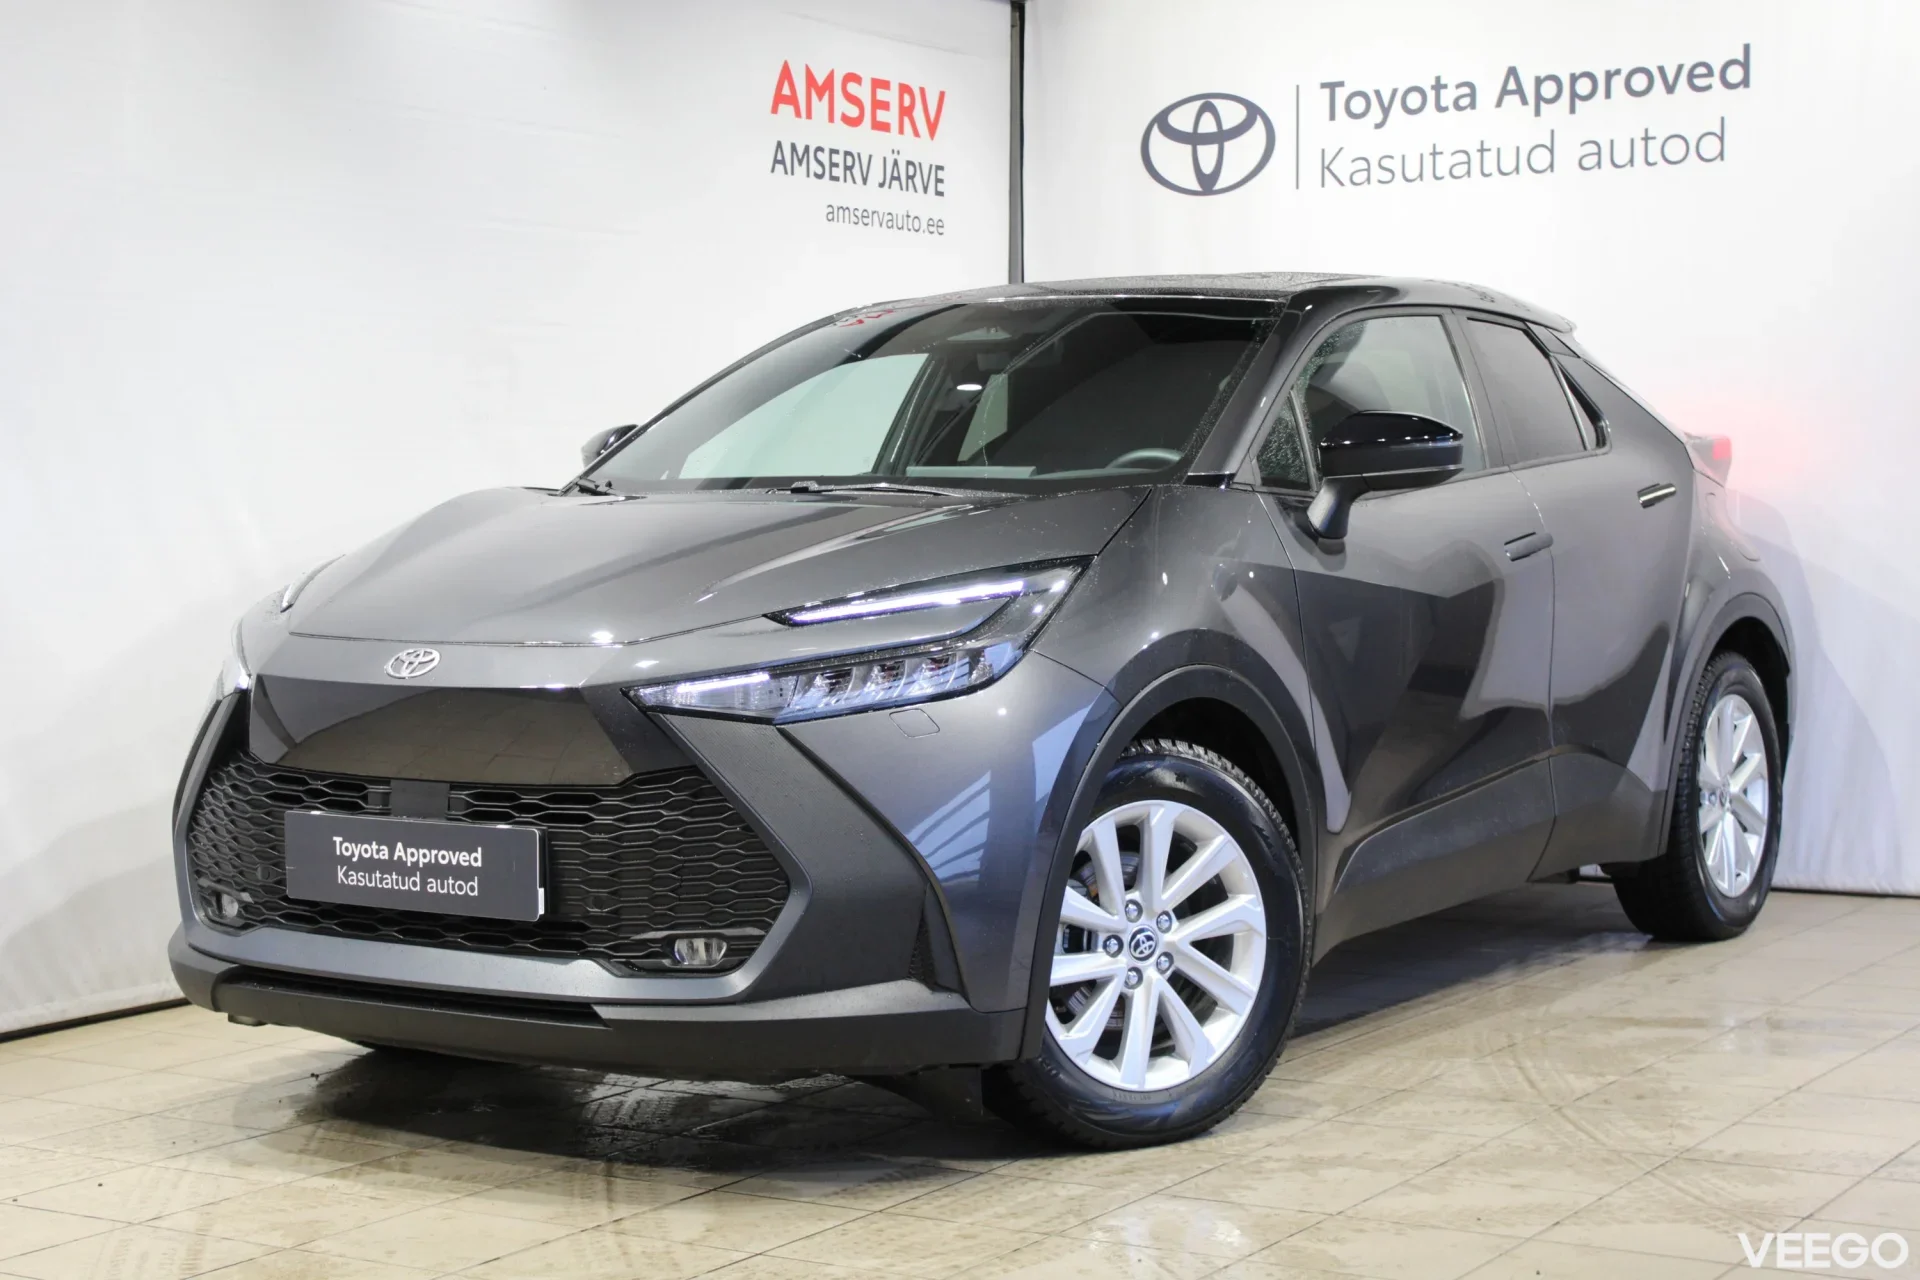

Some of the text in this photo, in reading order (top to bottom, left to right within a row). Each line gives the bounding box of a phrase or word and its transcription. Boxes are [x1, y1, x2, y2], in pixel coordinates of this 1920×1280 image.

[770, 59, 945, 141] AMSERV
[1320, 43, 1751, 129] Toyota Approved
[770, 140, 945, 197] AMSERV JÄRVE
[1320, 116, 1725, 188] Kasutatud autod
[826, 203, 945, 236] amservauto.ee
[333, 836, 482, 867] Toyota Approved
[337, 865, 478, 896] Kasutatud autod
